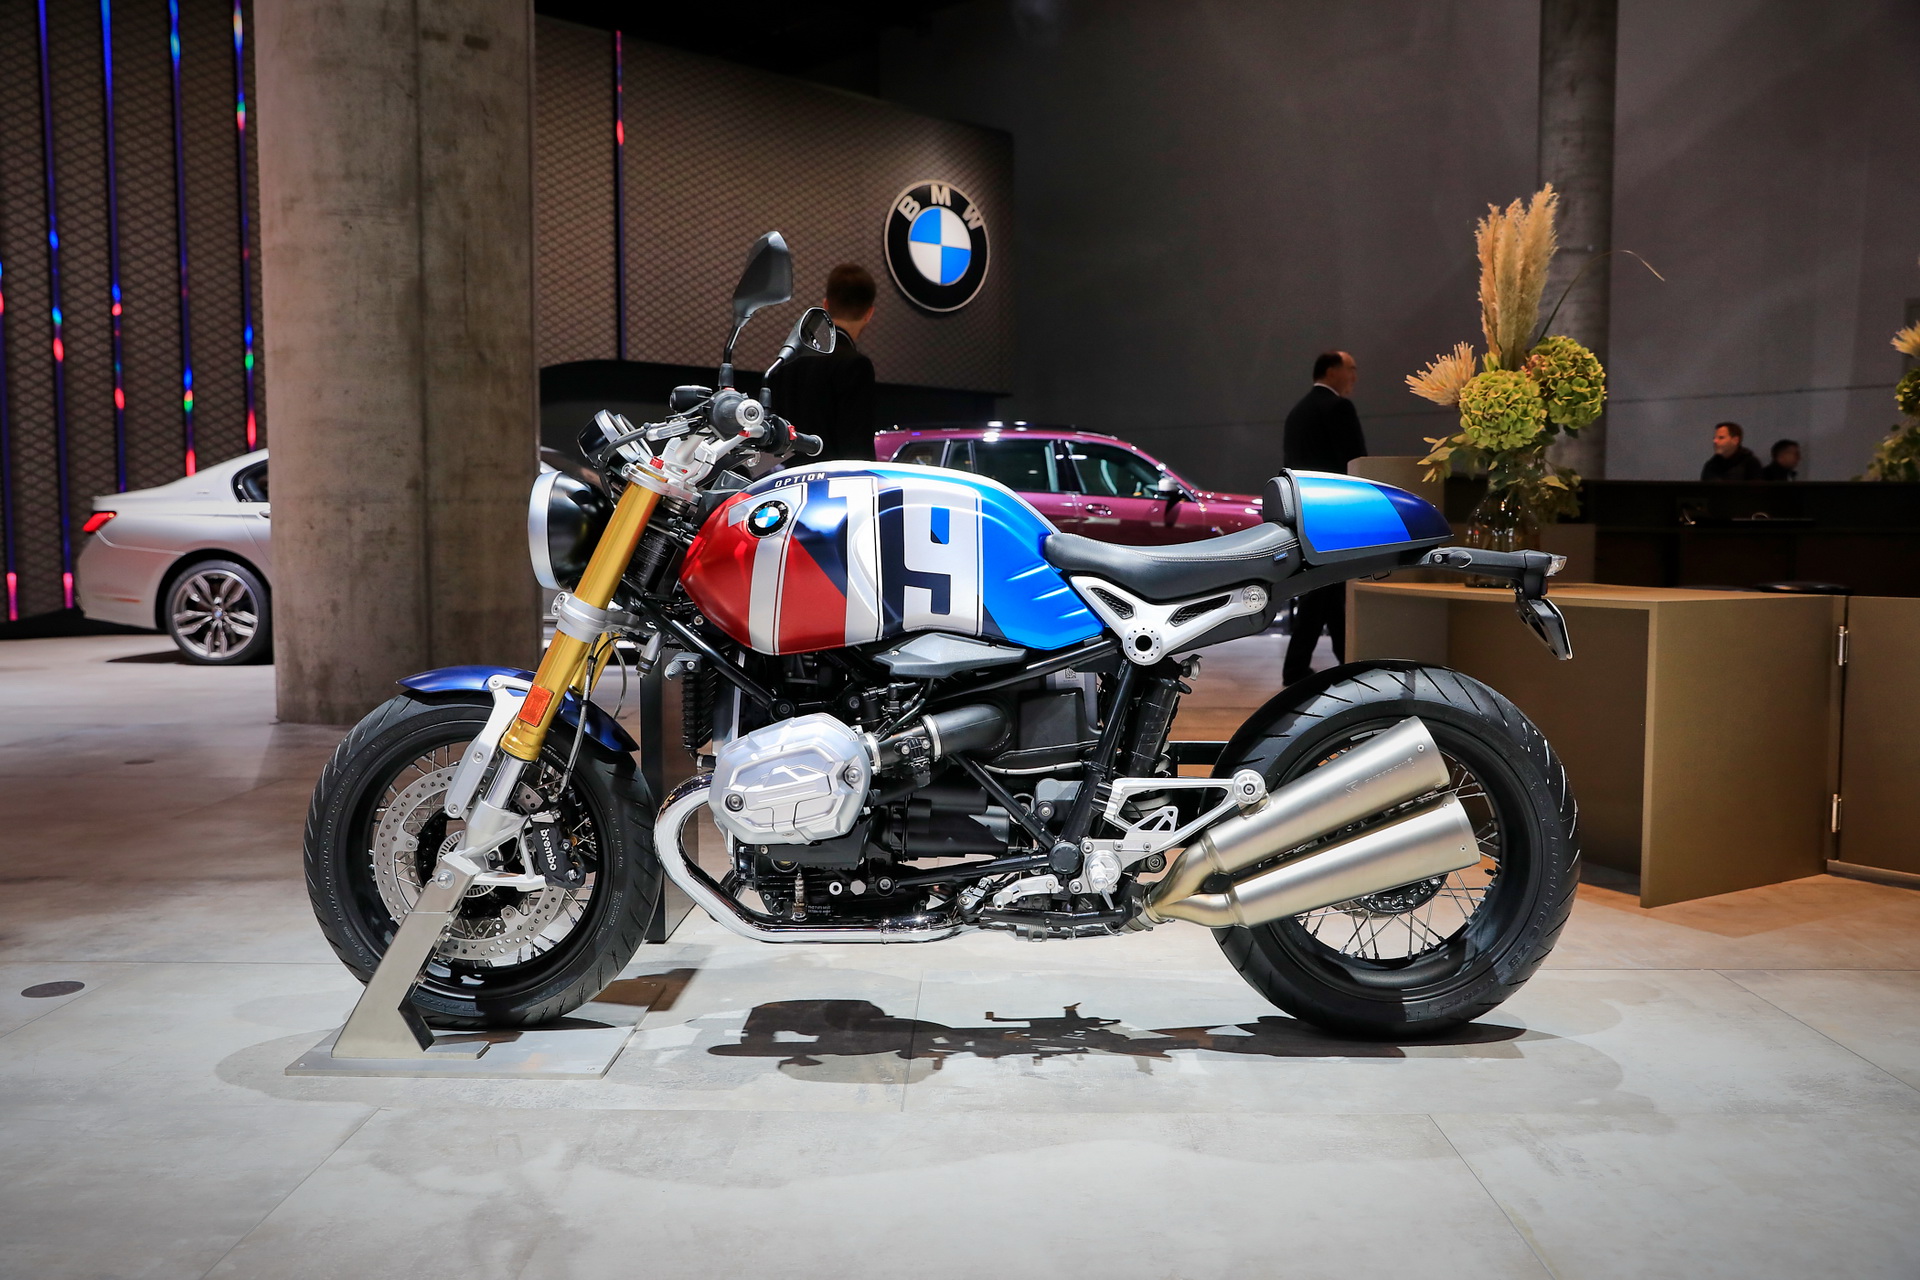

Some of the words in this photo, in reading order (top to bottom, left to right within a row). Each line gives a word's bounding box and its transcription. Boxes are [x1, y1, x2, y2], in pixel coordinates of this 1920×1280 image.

[897, 184, 983, 230] BMW
[775, 472, 825, 488] OPTION
[540, 828, 557, 871] brembo
